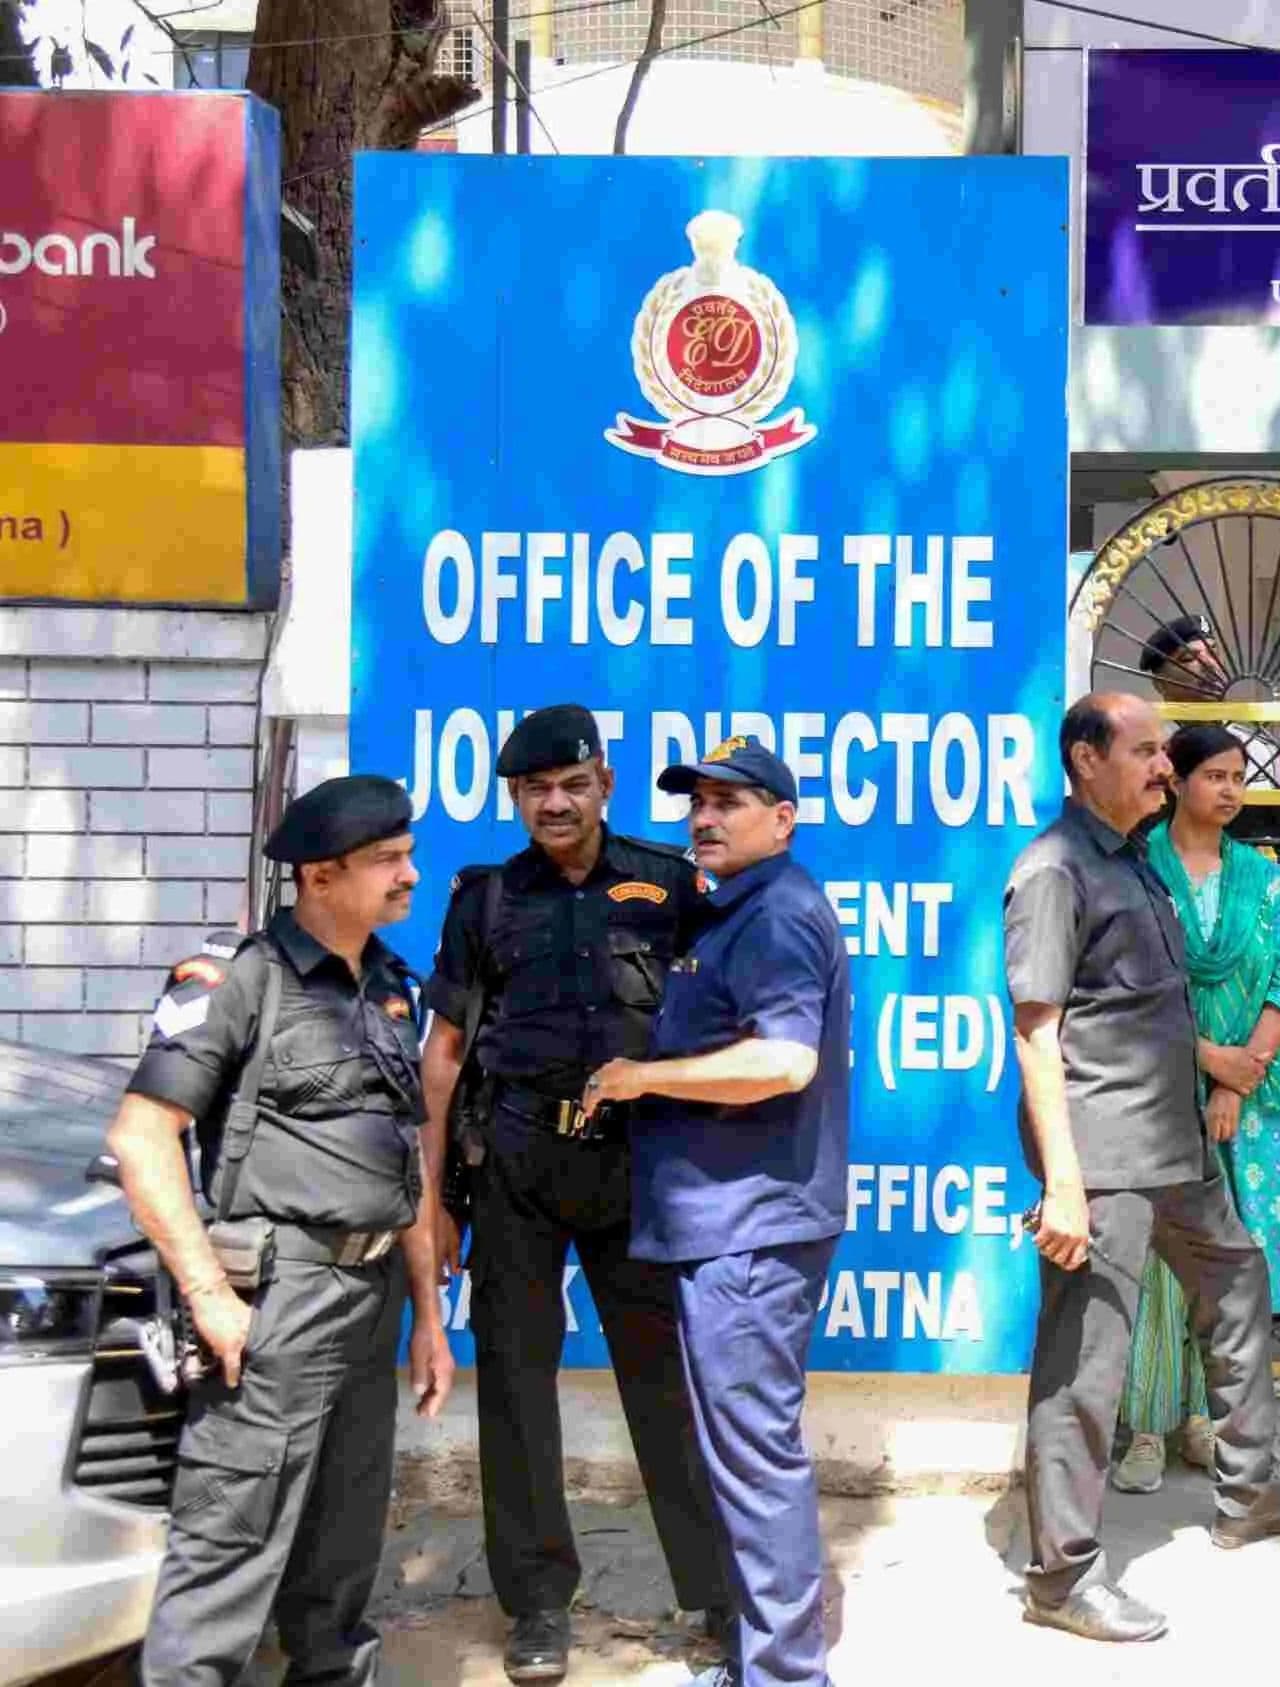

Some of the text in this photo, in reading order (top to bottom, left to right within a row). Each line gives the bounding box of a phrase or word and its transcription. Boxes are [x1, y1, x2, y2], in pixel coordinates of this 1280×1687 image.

[422, 529, 994, 648] OFFICE OF THE
[396, 707, 1037, 827] JOI DECTOR
[876, 993, 1006, 1092] (ED)
[845, 1164, 1025, 1251] FFICE,
[817, 1270, 985, 1342] ATNA
